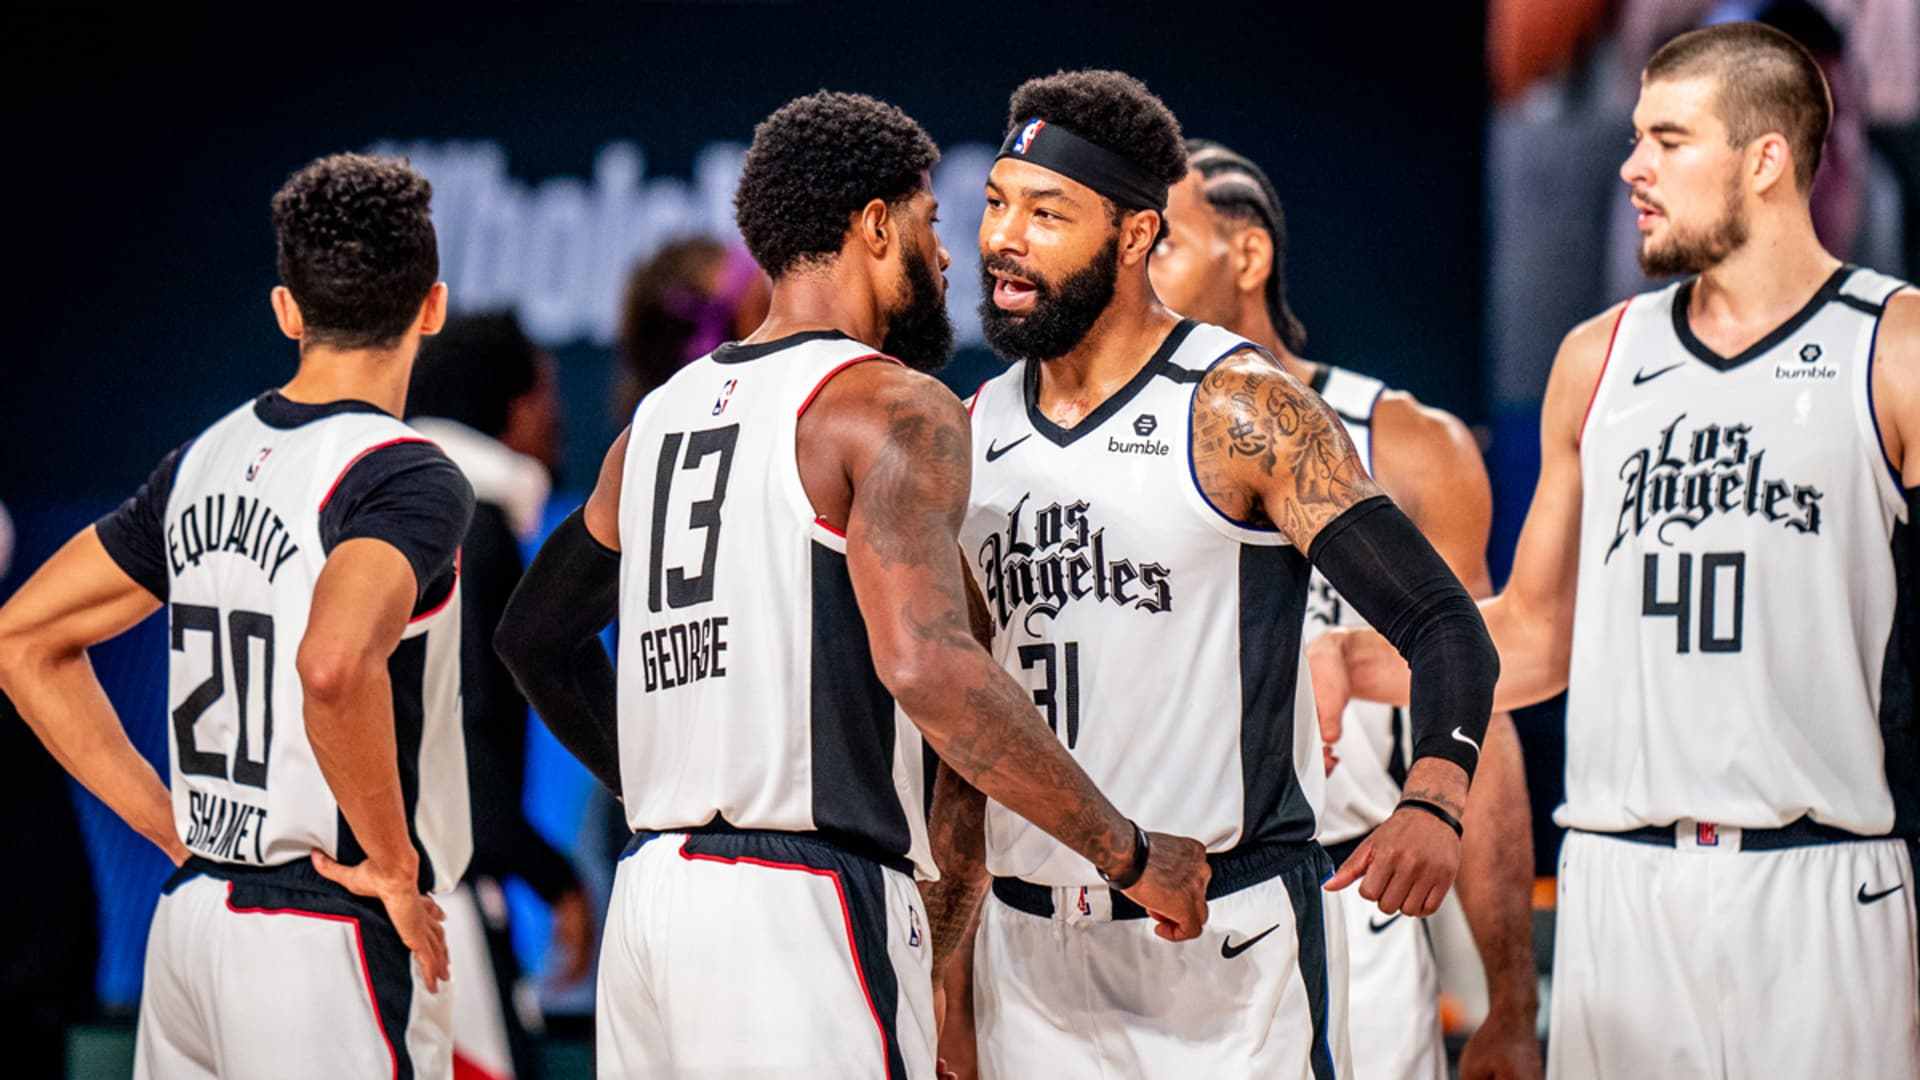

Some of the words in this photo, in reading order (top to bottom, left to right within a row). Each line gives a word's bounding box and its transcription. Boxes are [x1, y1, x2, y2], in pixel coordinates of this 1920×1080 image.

[1775, 366, 1837, 379] bumble
[1108, 437, 1169, 456] bumble
[1650, 412, 1752, 472] Los
[168, 493, 299, 584] EQUALITY
[648, 423, 740, 612] 13
[1001, 491, 1090, 558] Los
[1604, 448, 1824, 566] Angeles
[979, 527, 1172, 638] Angeles
[1641, 552, 1746, 654] 40
[170, 602, 275, 790] 20
[640, 616, 728, 693] GEORGE
[1017, 641, 1080, 750] 31
[186, 790, 268, 864] SHAMET
